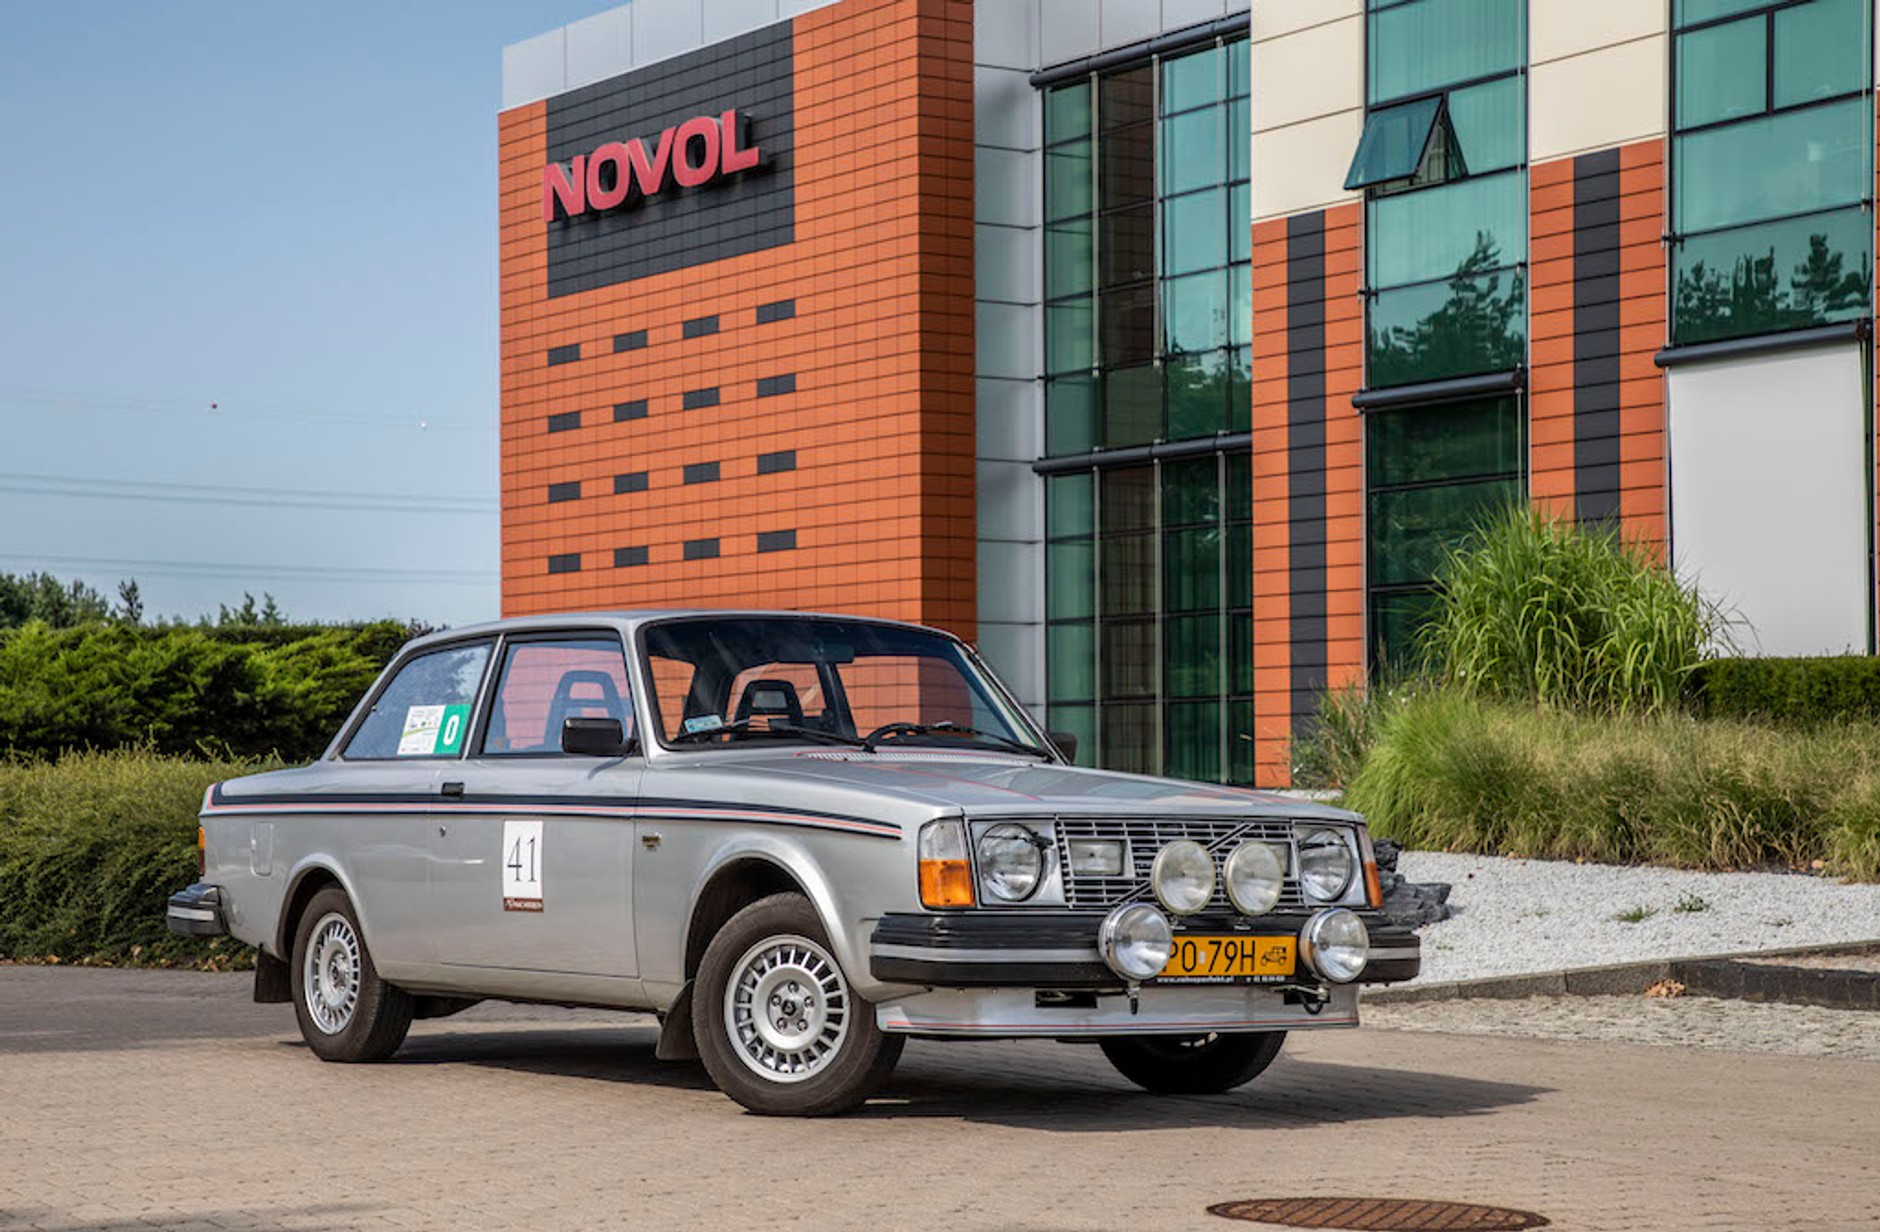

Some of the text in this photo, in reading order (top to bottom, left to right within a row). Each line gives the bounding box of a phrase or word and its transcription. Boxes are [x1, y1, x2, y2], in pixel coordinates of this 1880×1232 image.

[543, 108, 759, 222] NOVOL
[507, 836, 536, 882] 41
[1208, 940, 1256, 972] 79H
